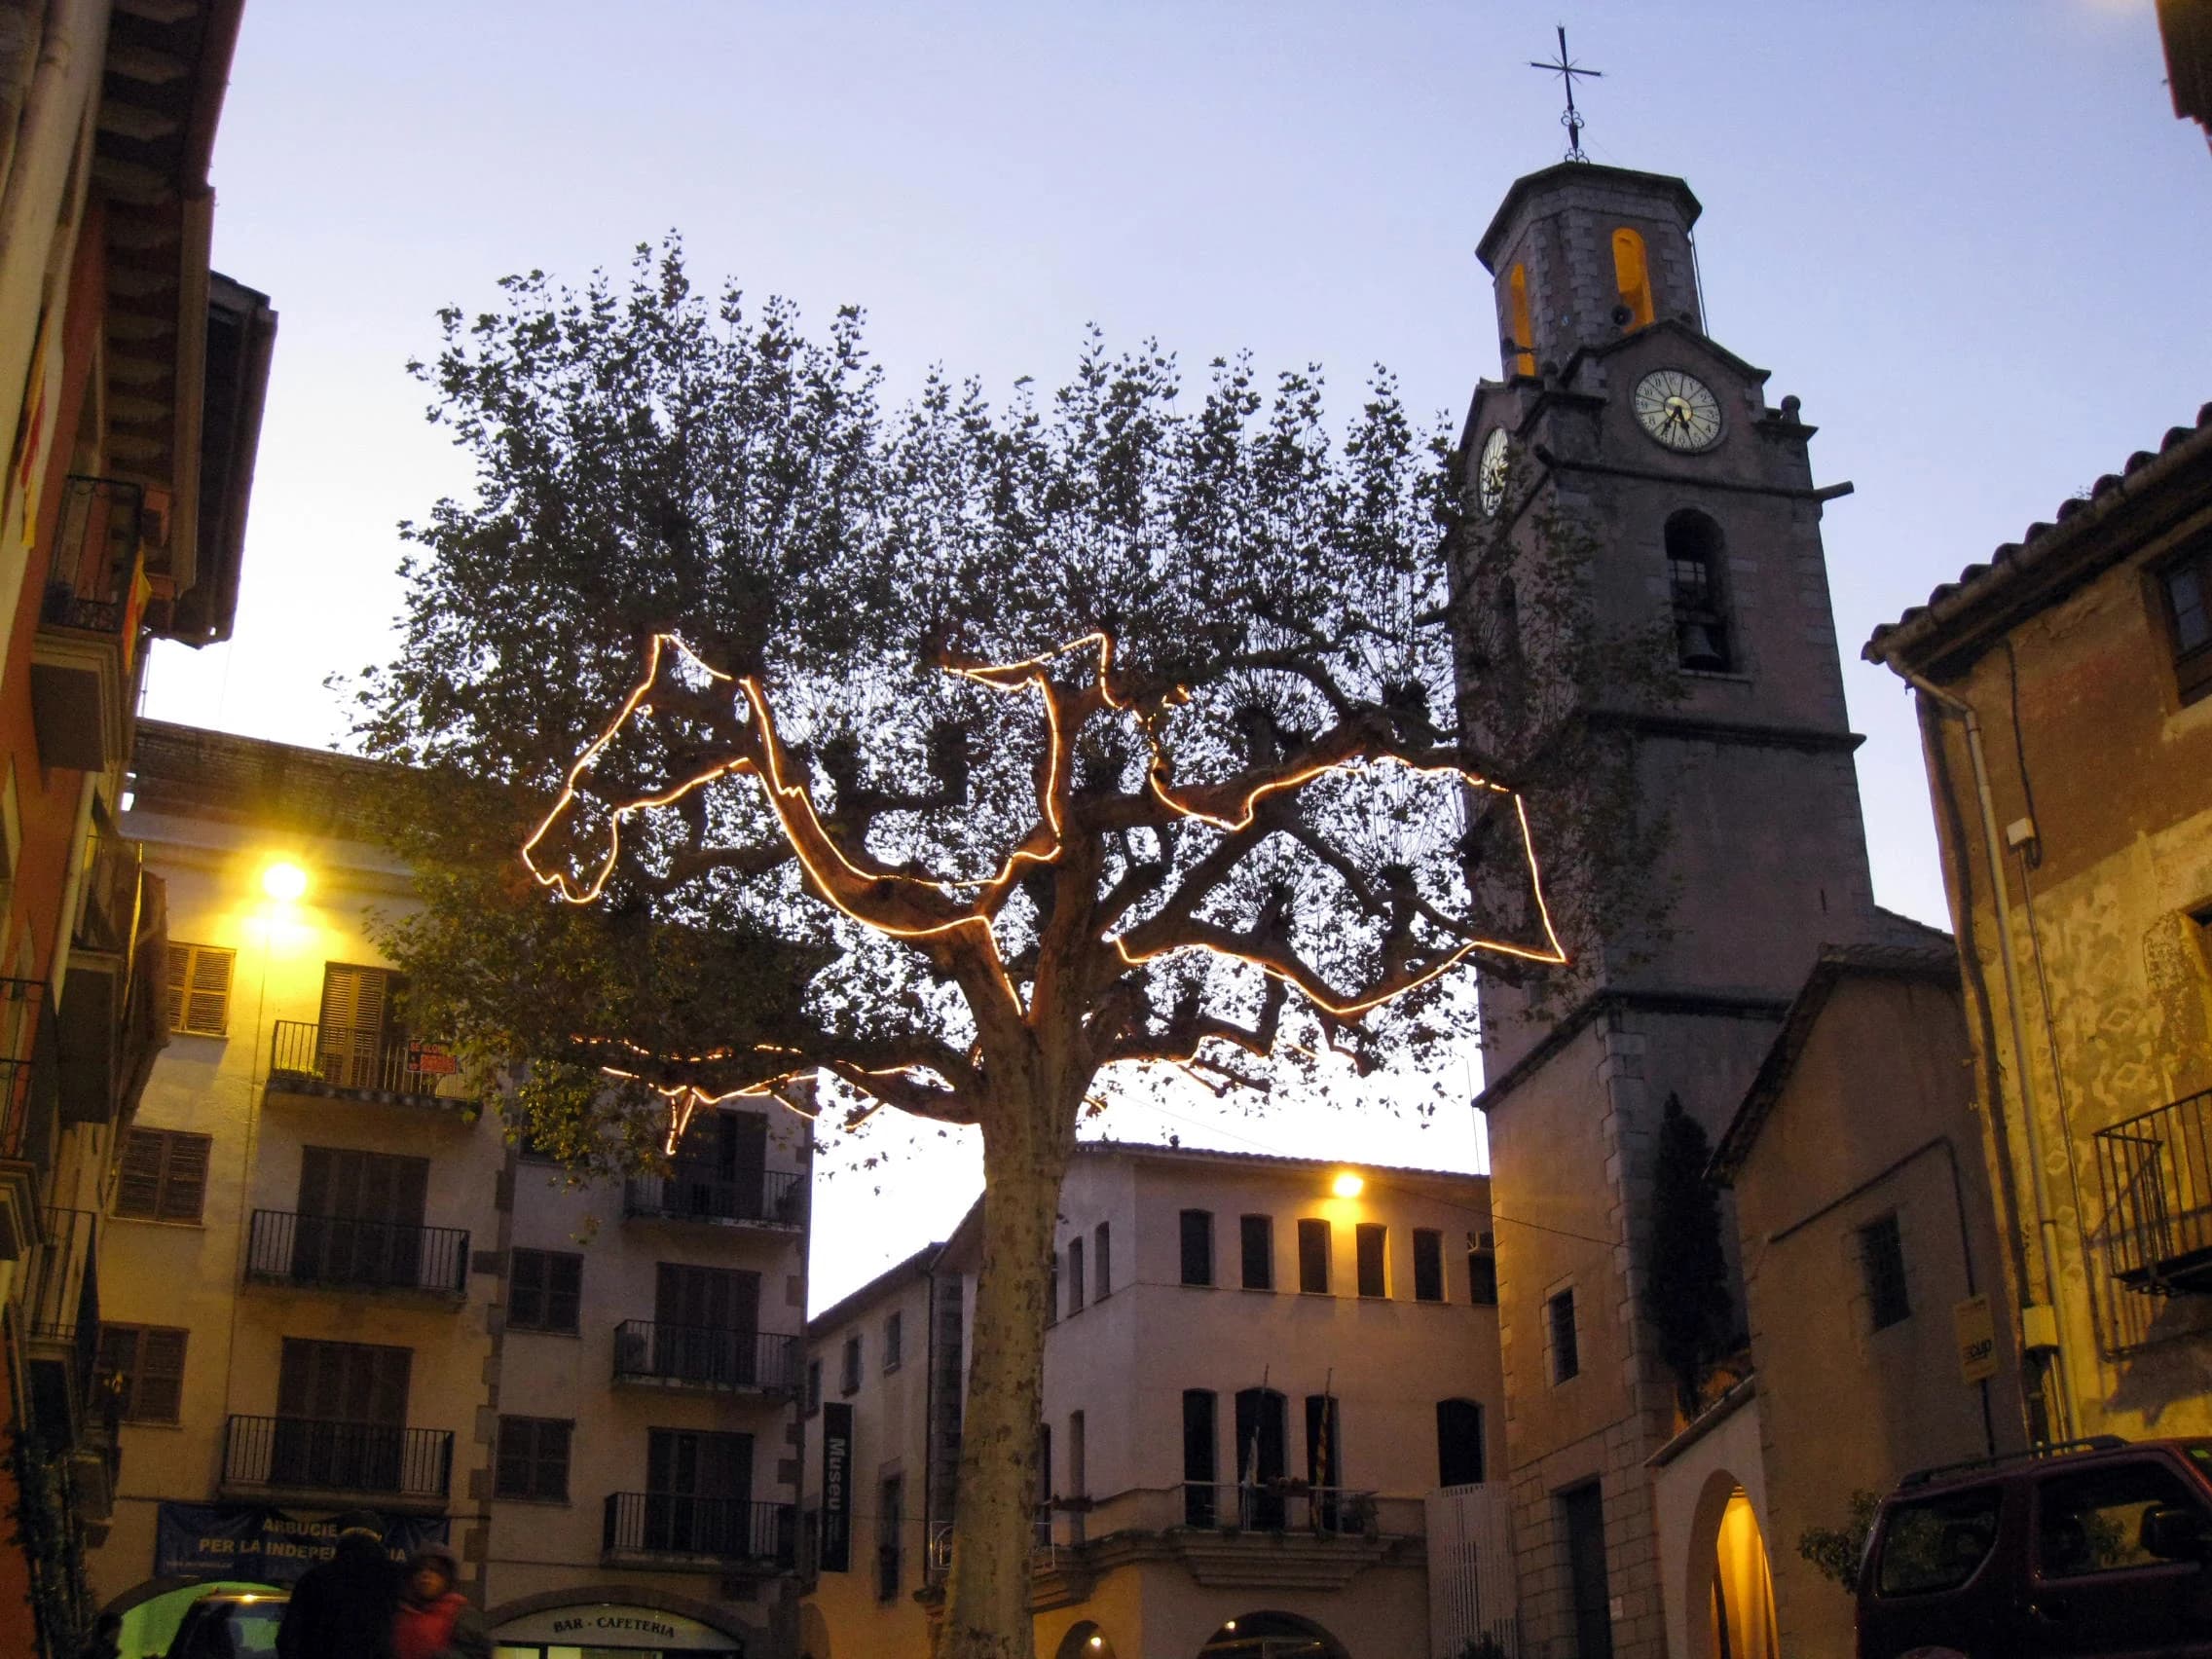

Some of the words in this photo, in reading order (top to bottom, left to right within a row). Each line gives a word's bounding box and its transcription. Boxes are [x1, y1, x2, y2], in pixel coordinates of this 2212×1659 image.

[829, 1437, 845, 1510] Museu
[199, 1537, 235, 1554] PER
[240, 1538, 261, 1554] LA
[553, 1617, 583, 1633] BAR
[597, 1616, 675, 1638] CAFETERIA
